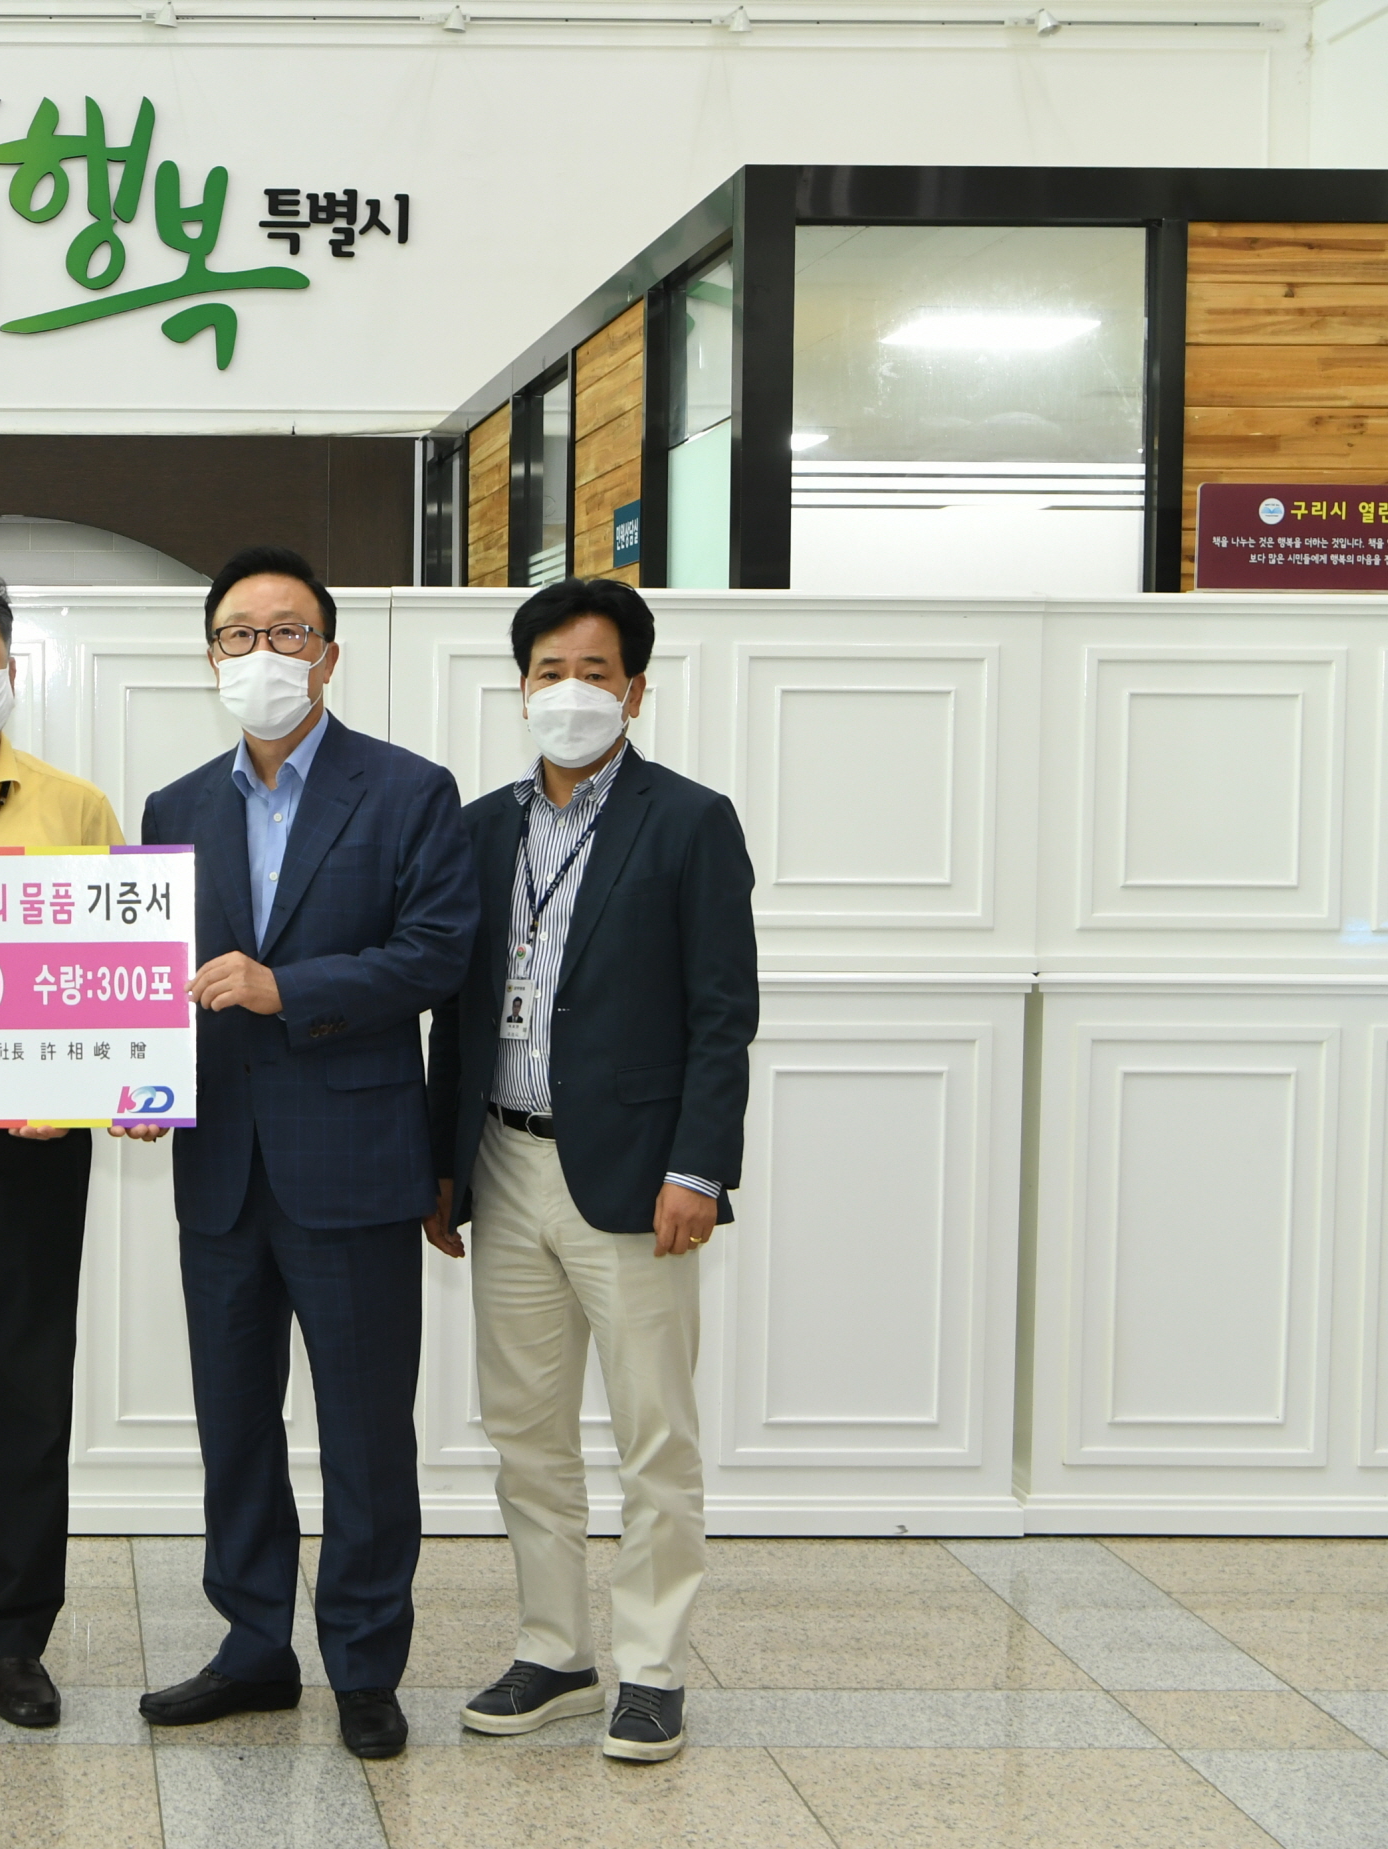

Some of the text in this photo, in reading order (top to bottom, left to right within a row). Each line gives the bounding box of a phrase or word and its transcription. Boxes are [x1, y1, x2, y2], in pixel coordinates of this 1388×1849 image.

[258, 188, 411, 259] 특별시
[1290, 501, 1347, 520] 구리시
[1231, 536, 1257, 548] 나누는
[1258, 536, 1275, 548] 것은
[1277, 537, 1302, 549] 행복을
[1304, 537, 1329, 549] 더하는
[1248, 553, 1266, 564] 보다
[1330, 553, 1355, 566] 행복의
[19, 882, 75, 925] 물품
[87, 882, 170, 925] 기증서
[33, 964, 174, 1006] 수량:300포
